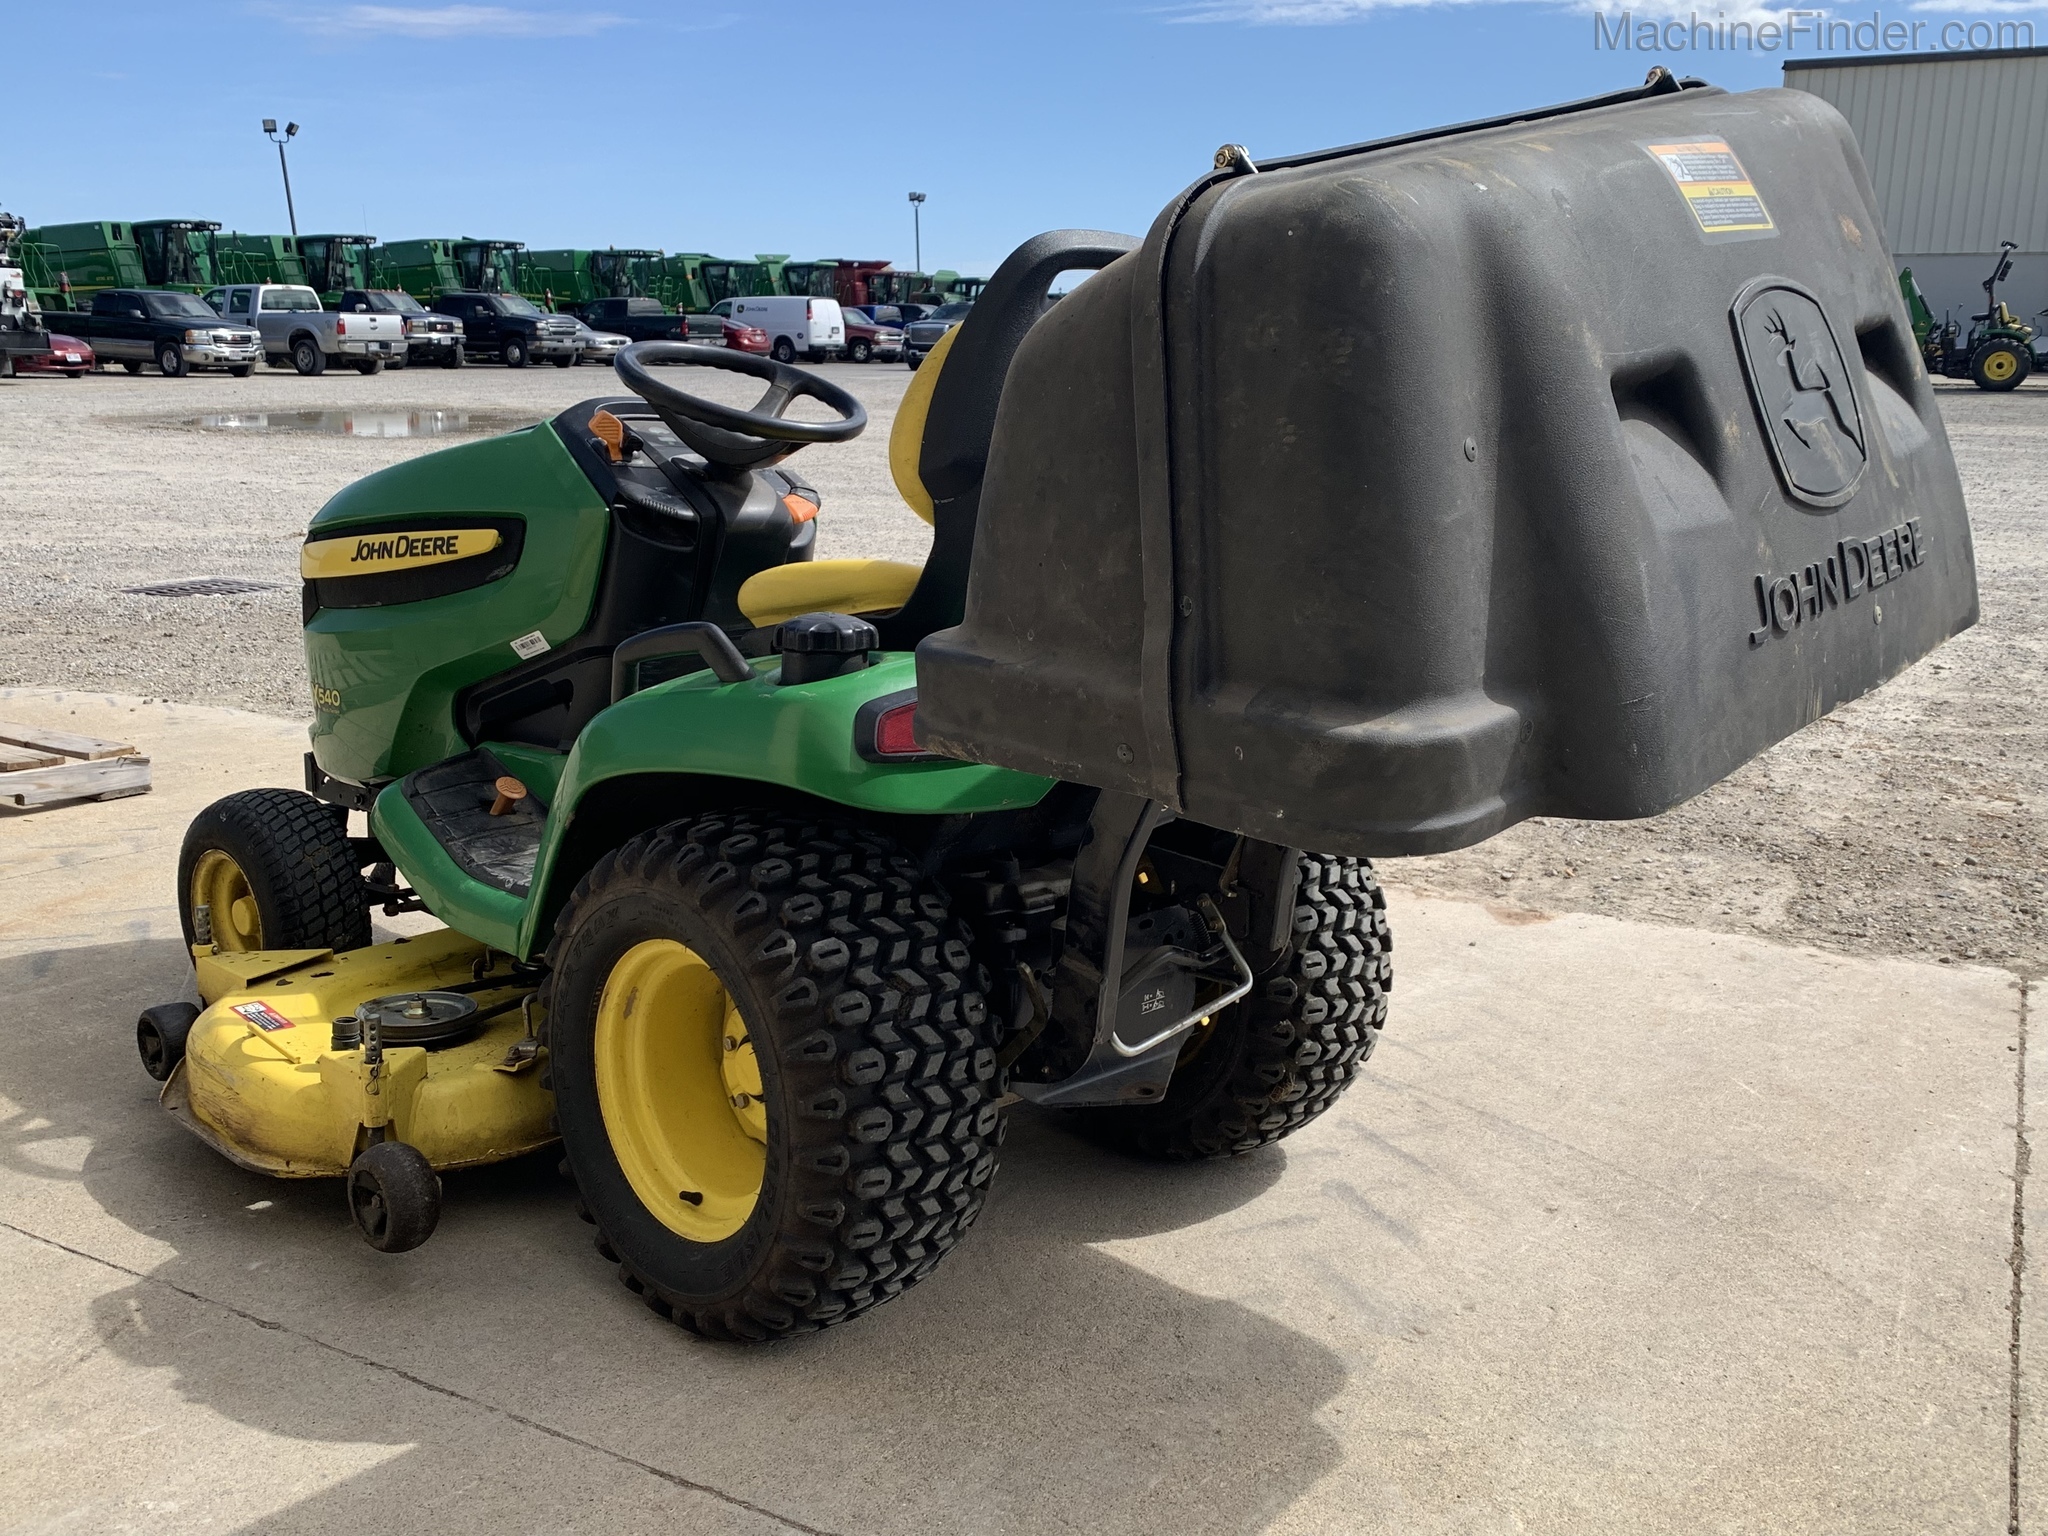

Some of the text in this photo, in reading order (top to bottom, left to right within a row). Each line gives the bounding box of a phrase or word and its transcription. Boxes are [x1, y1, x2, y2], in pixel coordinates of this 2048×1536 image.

[350, 535, 459, 562] JOHN DEERE
[1749, 516, 1927, 648] JOHN DEERE
[311, 682, 341, 709] X540
